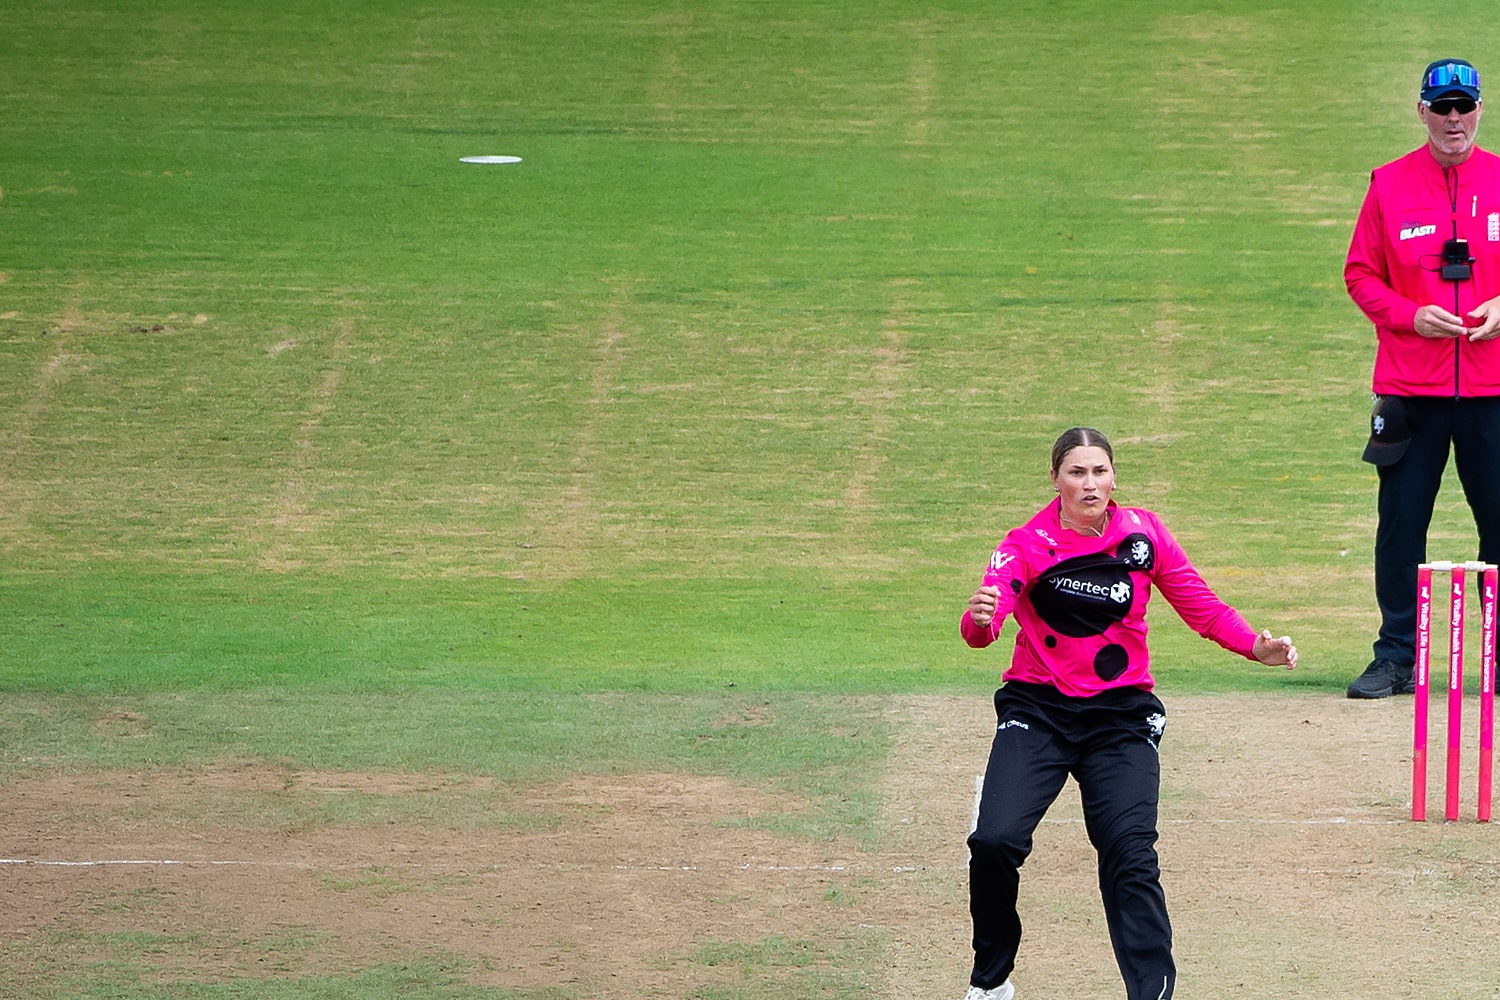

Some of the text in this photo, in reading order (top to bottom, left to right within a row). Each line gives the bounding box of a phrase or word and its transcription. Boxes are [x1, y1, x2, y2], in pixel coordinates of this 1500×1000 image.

[1419, 602, 1429, 630] Vitality
[1452, 598, 1461, 626] Vitality
[1484, 602, 1493, 629] Vitality
